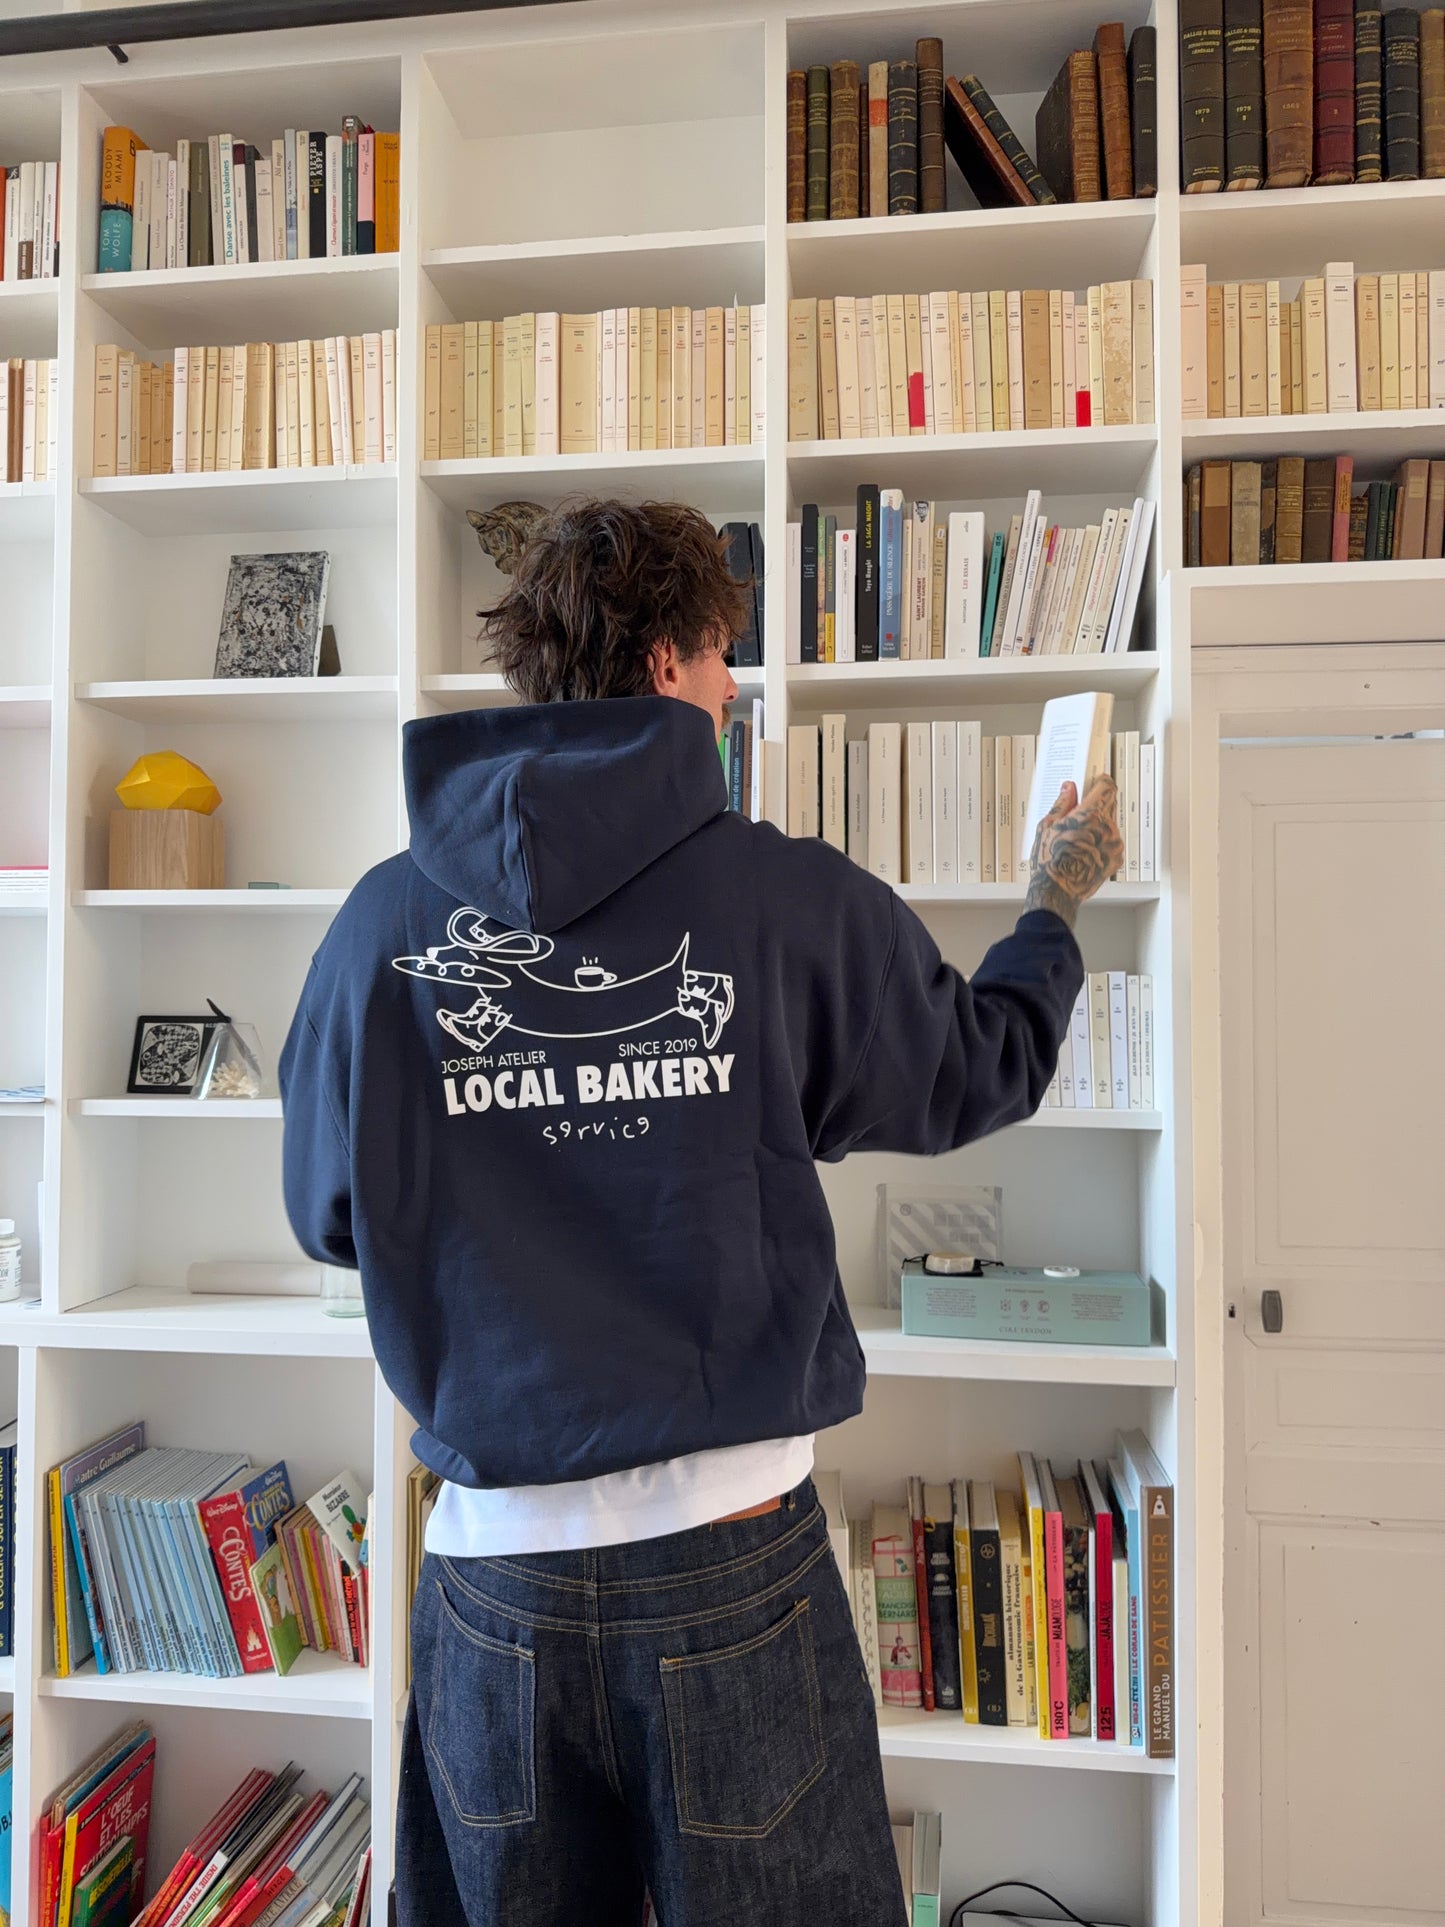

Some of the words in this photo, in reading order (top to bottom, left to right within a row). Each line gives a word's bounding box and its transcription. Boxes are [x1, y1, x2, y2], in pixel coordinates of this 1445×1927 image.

[105, 148, 113, 190] BLOODY
[115, 149, 123, 184] MIAMI
[222, 160, 230, 194] baleines
[112, 223, 121, 258] WOLFE
[733, 785, 738, 793] de
[618, 1041, 660, 1057] SINCE
[664, 1038, 697, 1054] 2019
[441, 1056, 494, 1074] JOSEPH
[498, 1050, 546, 1067] ATELIER
[444, 1068, 564, 1116] LOCAL
[576, 1054, 735, 1104] BAKERY
[96, 1442, 138, 1471] Guillaume
[322, 1484, 342, 1501] Monsieur
[326, 1490, 350, 1513] BIZARRE
[252, 1482, 290, 1531] CONTES
[219, 1526, 251, 1601] CONTES
[1005, 1564, 1013, 1612] historique
[1013, 1564, 1021, 1607] française
[1152, 1534, 1169, 1666] PATISSIER
[1132, 1619, 1137, 1629] DE
[1132, 1659, 1138, 1668] LE
[1016, 1674, 1023, 1682] la
[1017, 1684, 1023, 1696] de
[1161, 1674, 1170, 1690] DU
[1162, 1692, 1170, 1740] MANUEL
[1154, 1727, 1161, 1740] LE
[100, 1823, 113, 1846] ET
[115, 1803, 132, 1830] LES
[199, 1864, 218, 1889] INSIDE
[188, 1887, 203, 1902] THE
